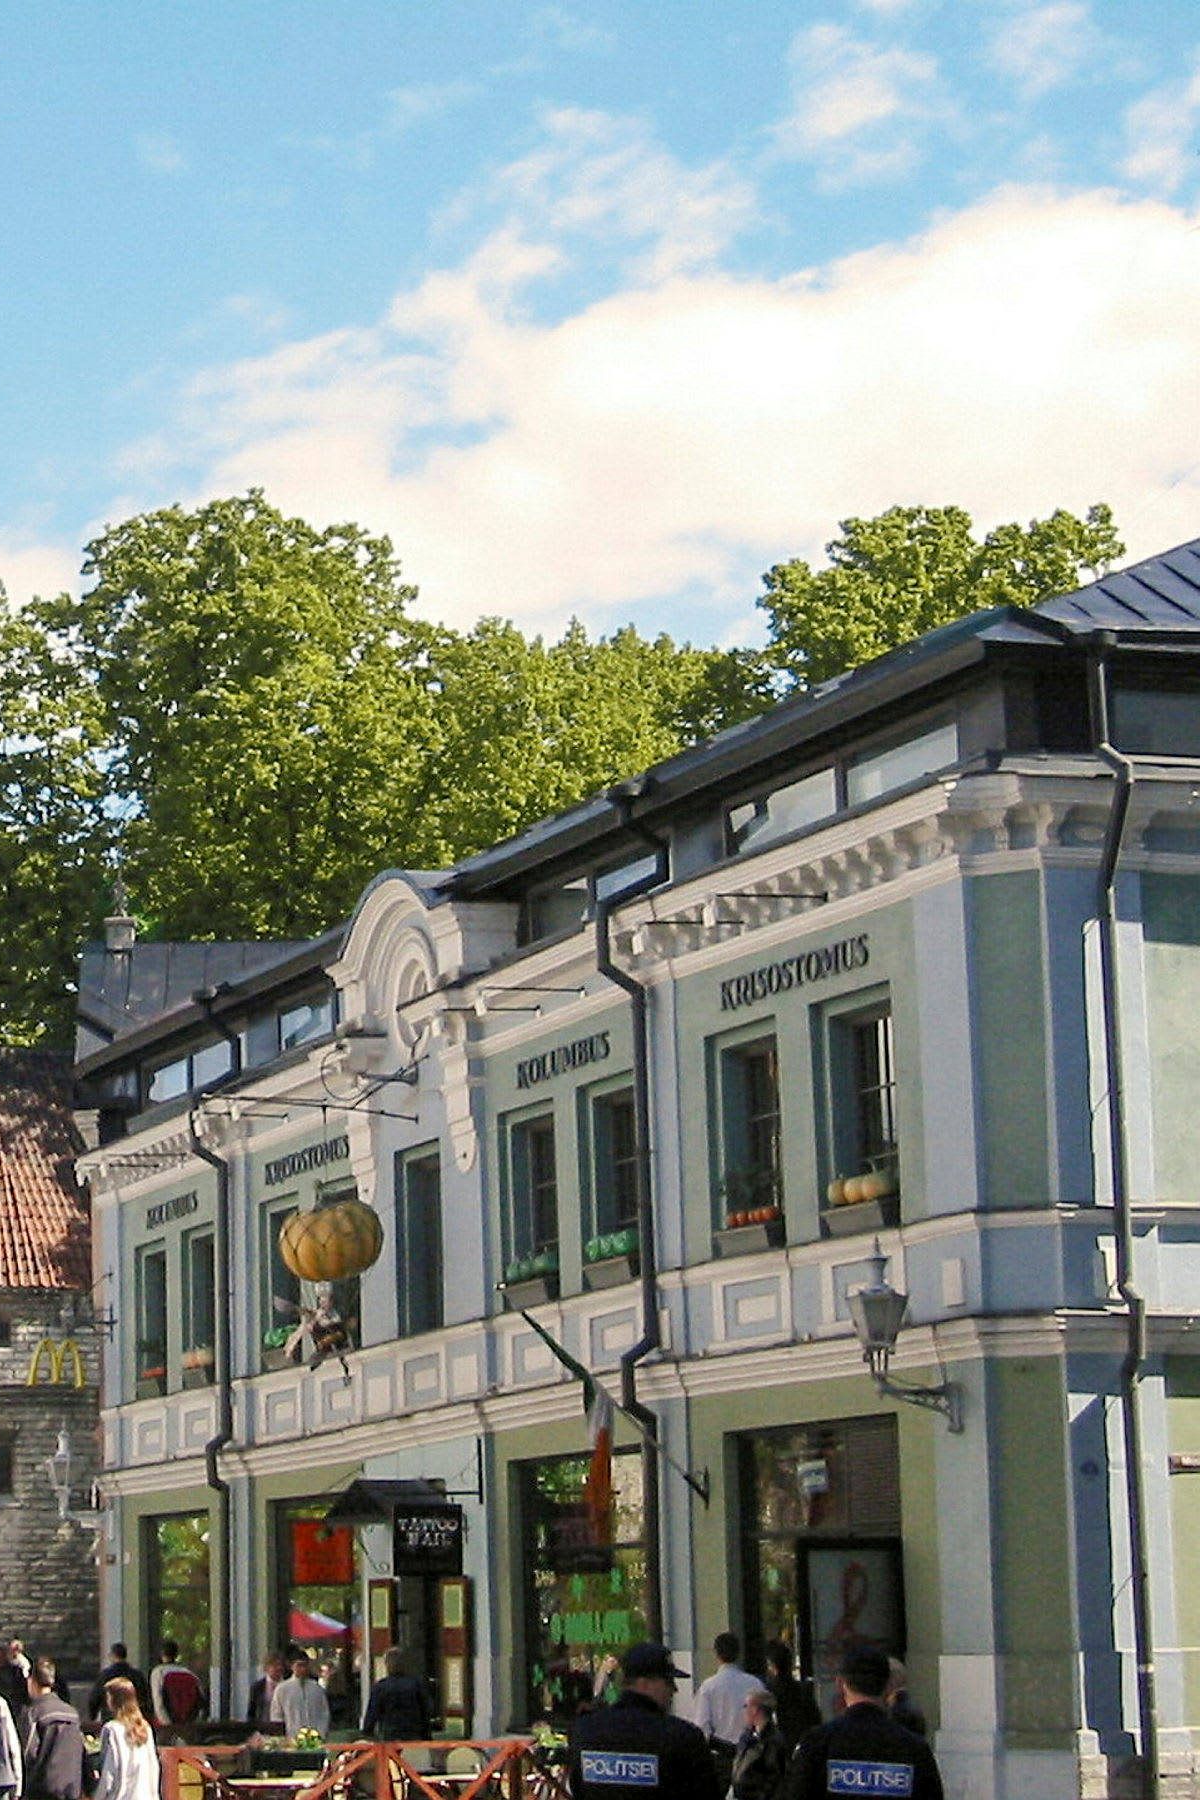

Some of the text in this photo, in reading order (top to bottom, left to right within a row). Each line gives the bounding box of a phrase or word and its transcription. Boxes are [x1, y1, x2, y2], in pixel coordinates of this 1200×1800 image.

[720, 933, 869, 1011] KRISOSTOMUS
[517, 1030, 610, 1089] KOLUMBUS
[398, 1517, 459, 1532] TATTOO
[583, 1758, 657, 1777] POLITSEI
[830, 1769, 910, 1788] POLITSEI
